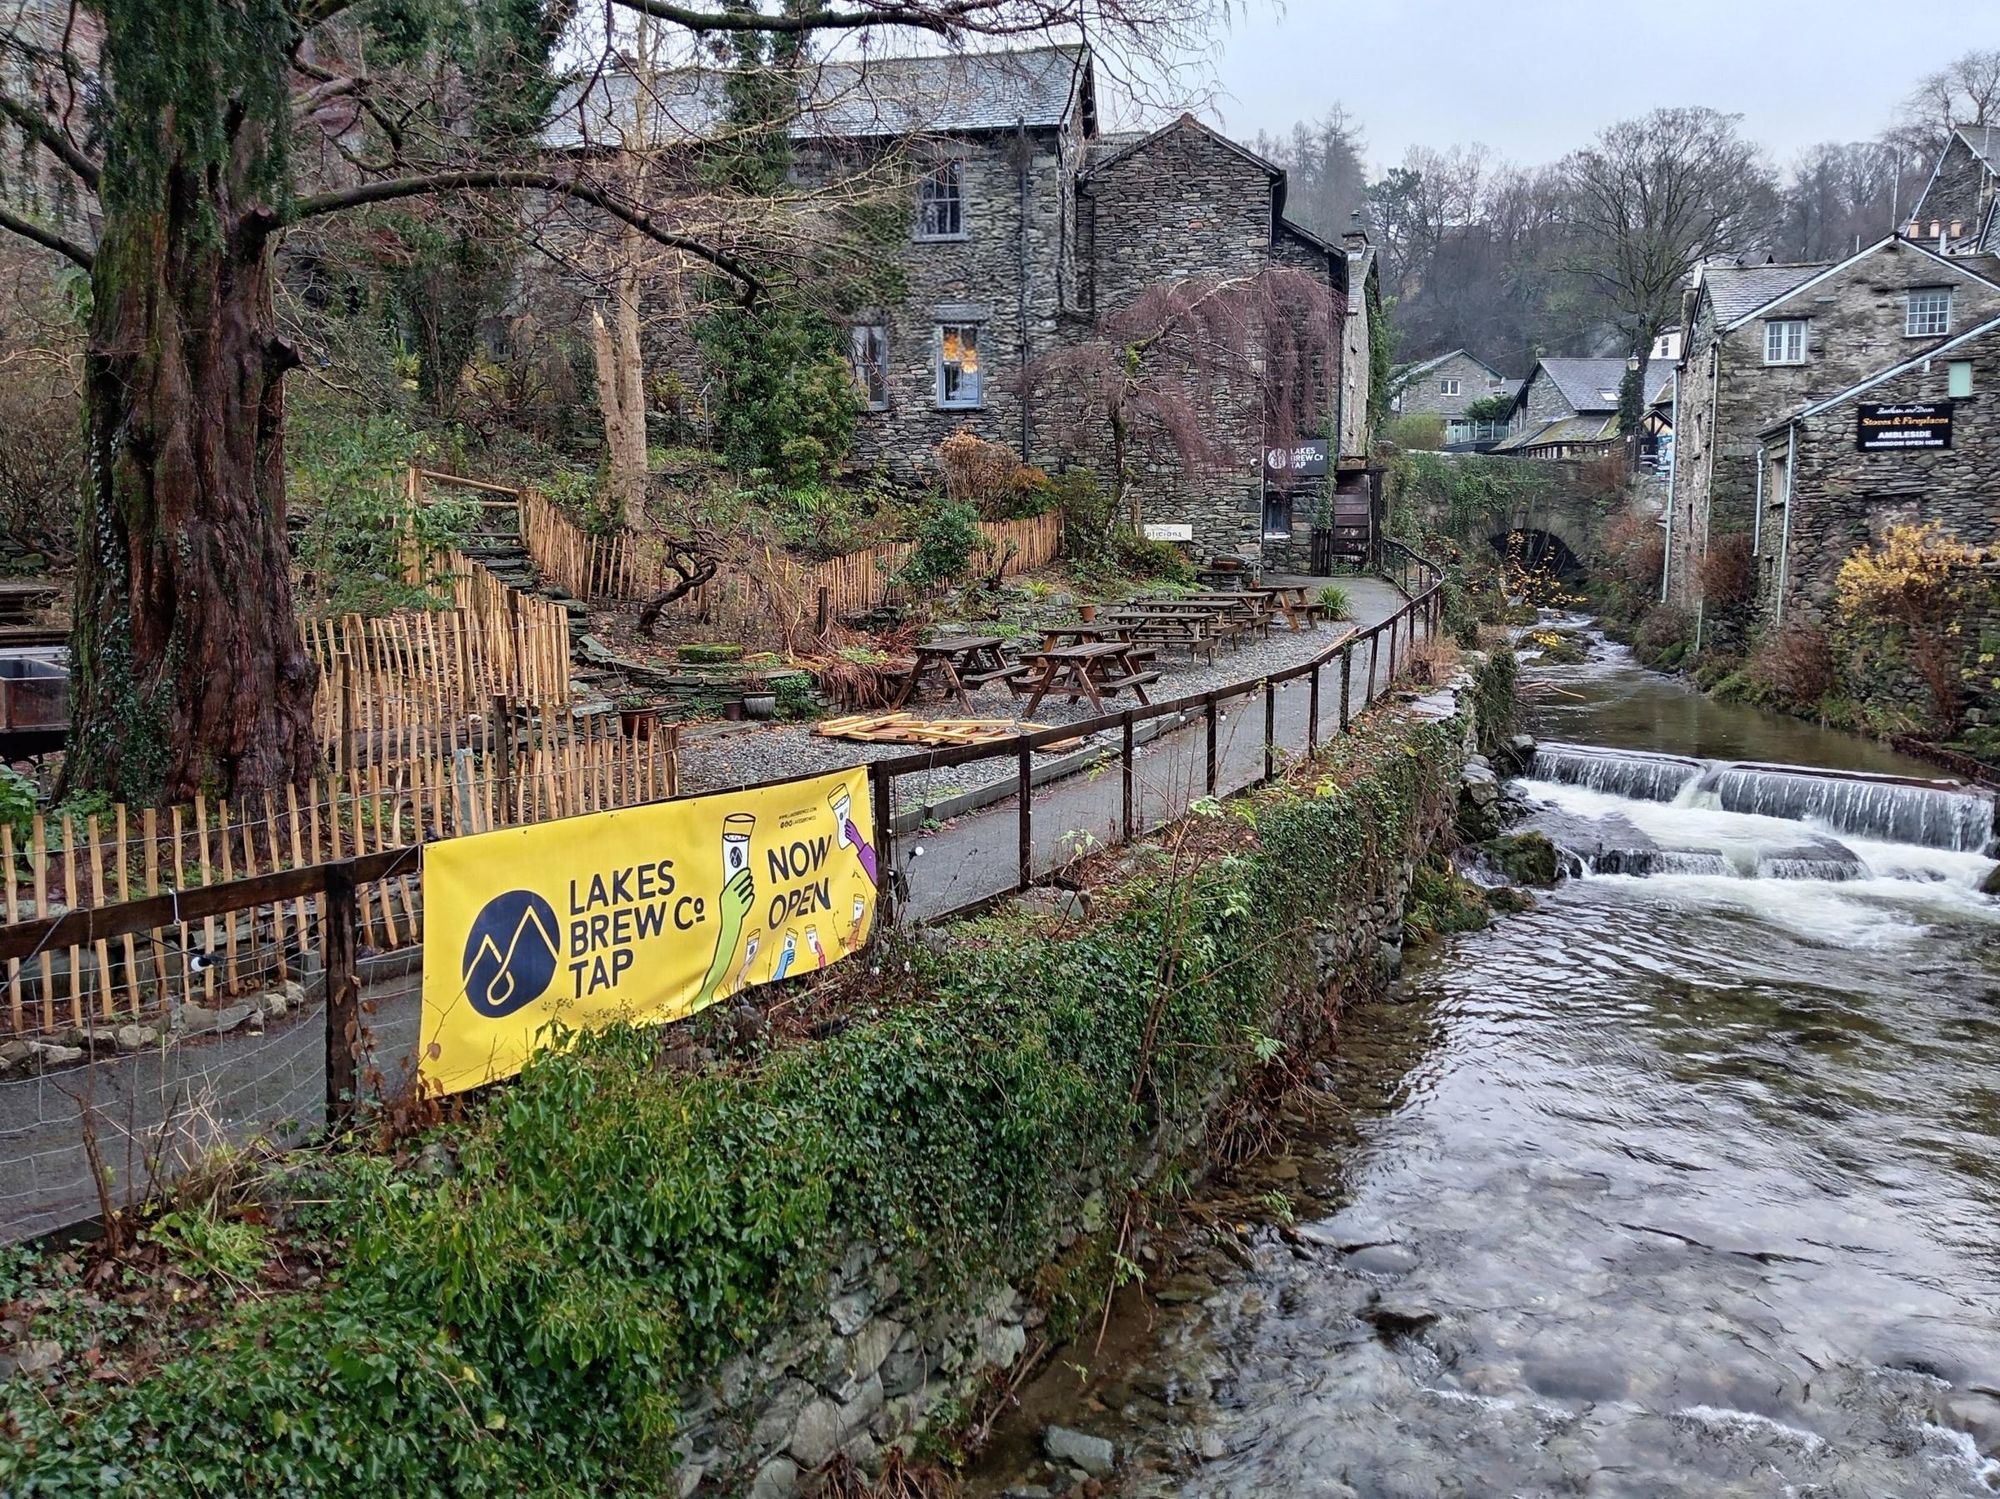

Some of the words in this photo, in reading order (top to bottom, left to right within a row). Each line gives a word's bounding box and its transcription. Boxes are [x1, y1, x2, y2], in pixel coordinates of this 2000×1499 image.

[1862, 417, 1891, 426] Stoves
[1892, 416, 1901, 425] &
[1902, 415, 1949, 426] Fireplaces
[1877, 430, 1932, 439] AMBLESIDE
[1290, 446, 1316, 455] LAKES
[1290, 454, 1314, 462] BREW
[1290, 461, 1307, 469] TAP
[767, 834, 833, 884] NOW
[569, 859, 676, 916] LAKES
[768, 877, 832, 930] OPEN
[570, 901, 667, 959] BREW
[568, 949, 634, 999] TAP
